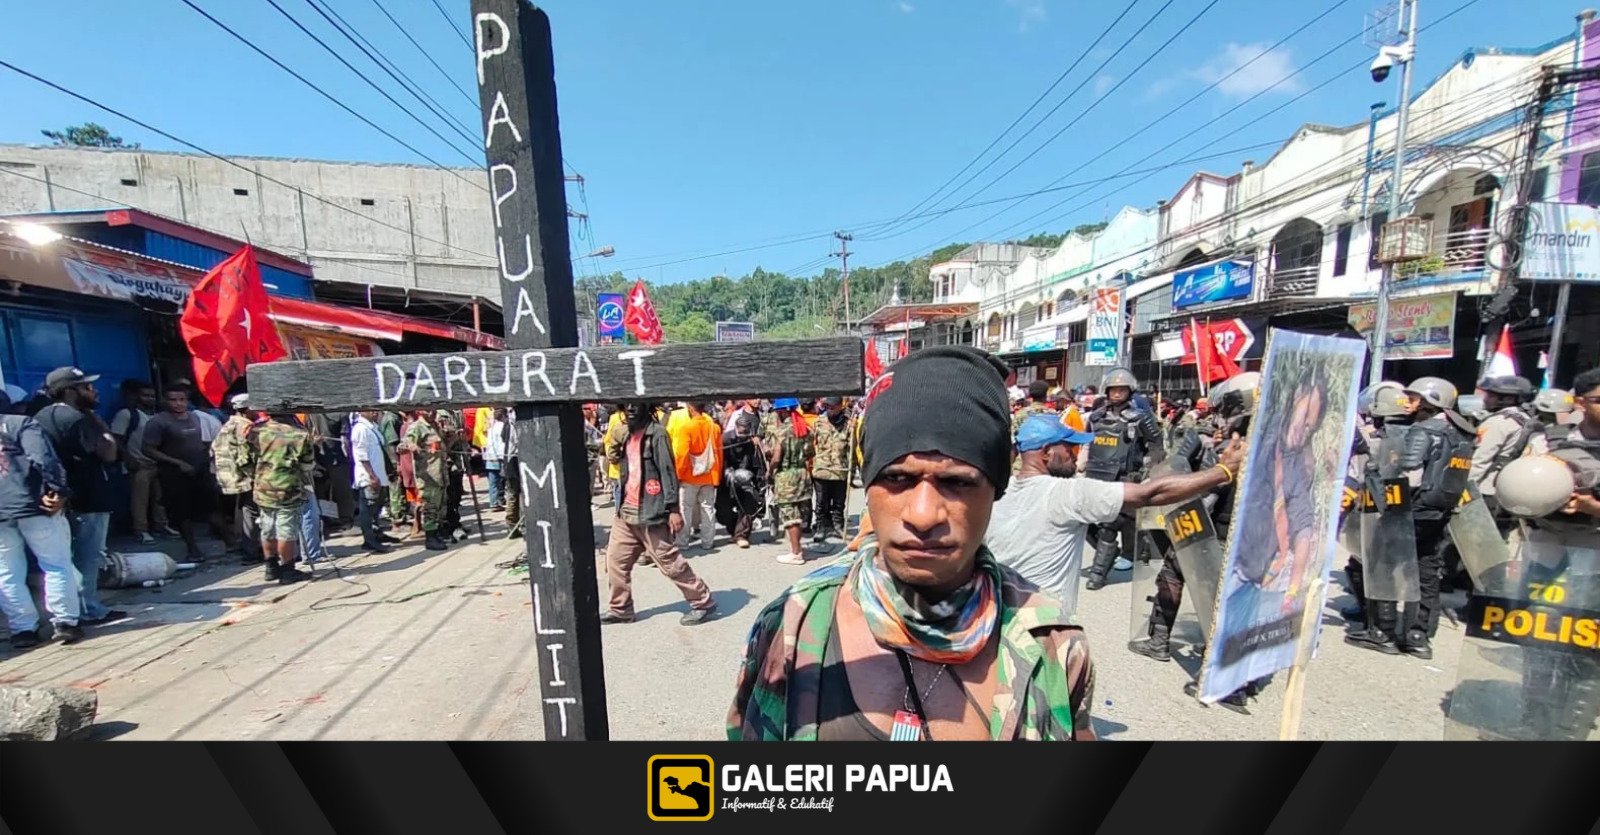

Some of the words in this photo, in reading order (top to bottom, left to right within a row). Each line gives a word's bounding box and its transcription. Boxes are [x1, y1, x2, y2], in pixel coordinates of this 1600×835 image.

[474, 12, 546, 336] PAPUA
[1533, 230, 1591, 248] mandiri
[1095, 316, 1117, 328] BNI
[375, 350, 657, 404] DARURAT
[519, 459, 577, 738] MILIT
